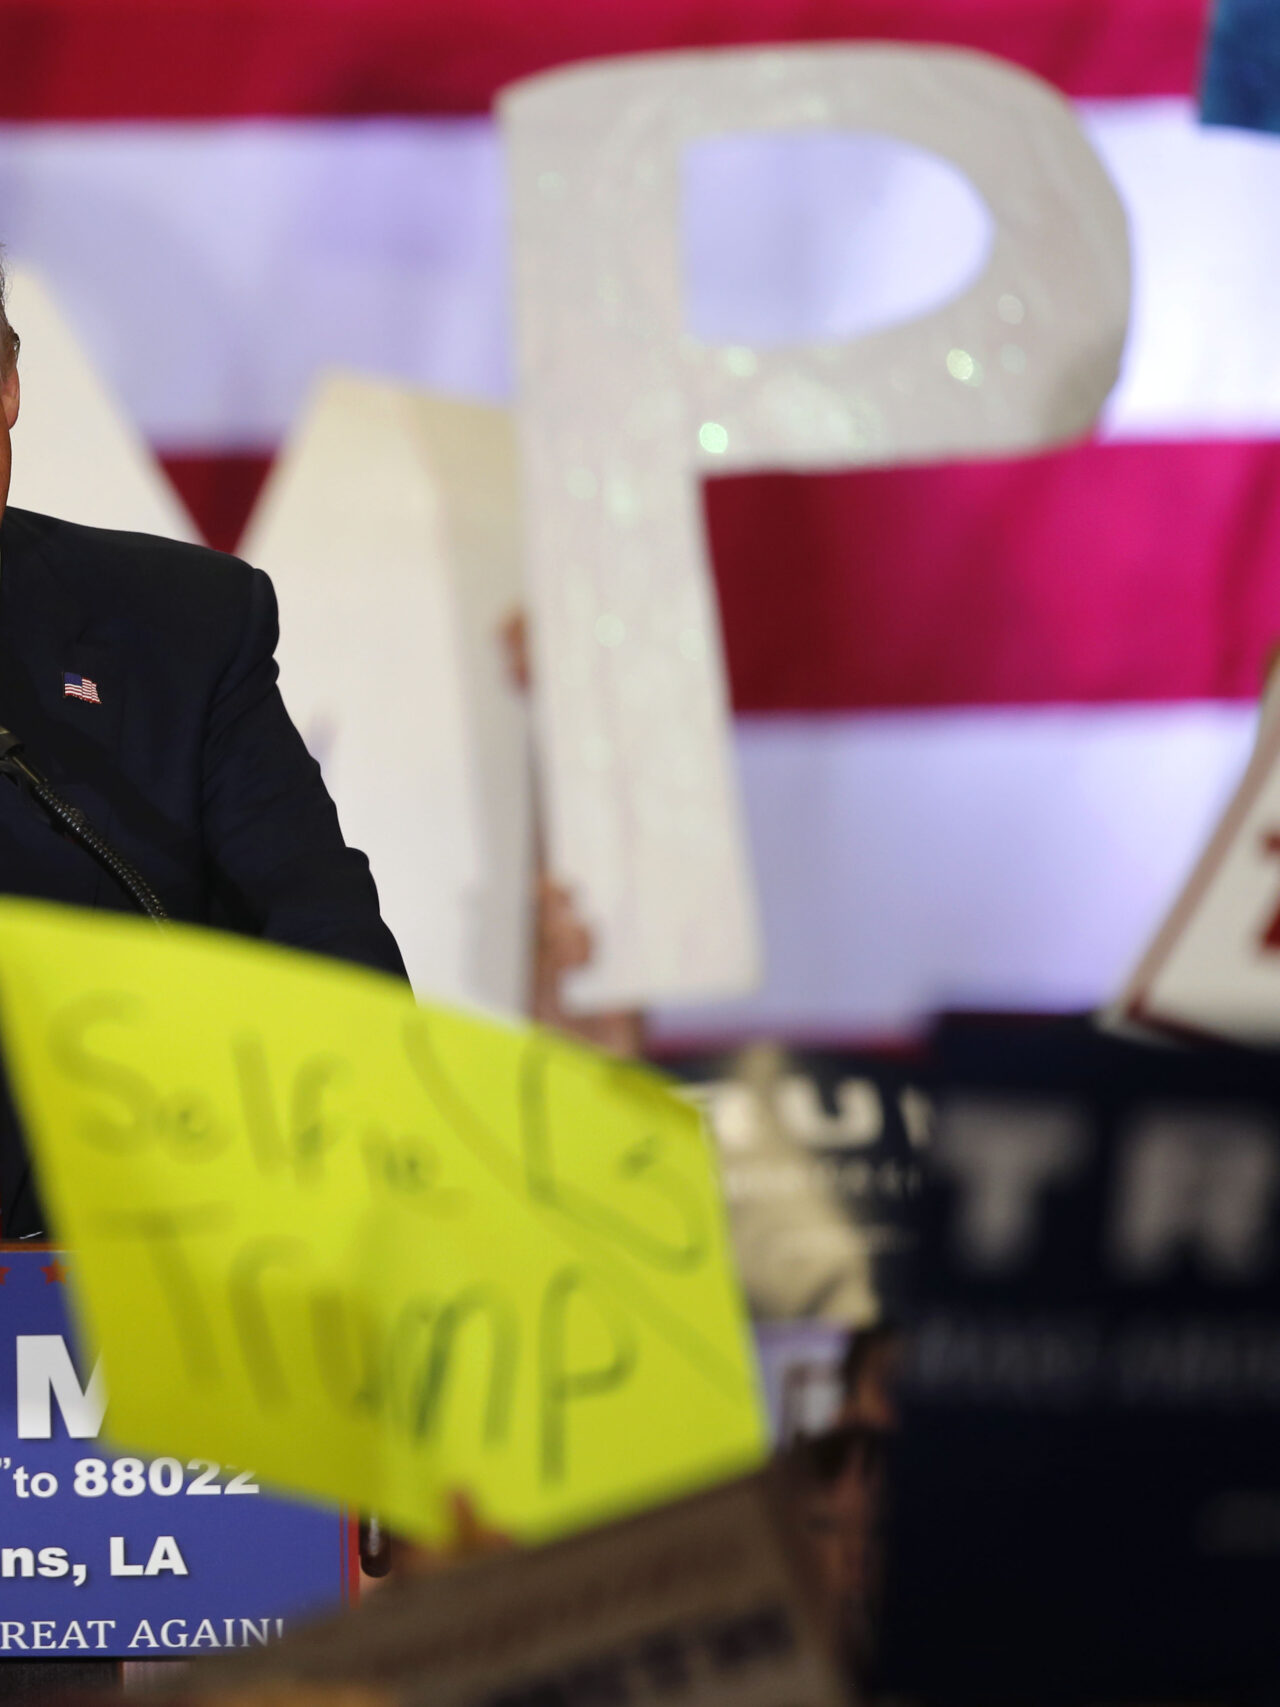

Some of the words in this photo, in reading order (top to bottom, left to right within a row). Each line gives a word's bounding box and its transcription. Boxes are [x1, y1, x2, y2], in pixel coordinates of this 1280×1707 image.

[13, 1466, 59, 1499] to
[73, 1457, 260, 1498] 88022
[109, 1535, 189, 1577] LA
[128, 1617, 285, 1649] AGAIN!
